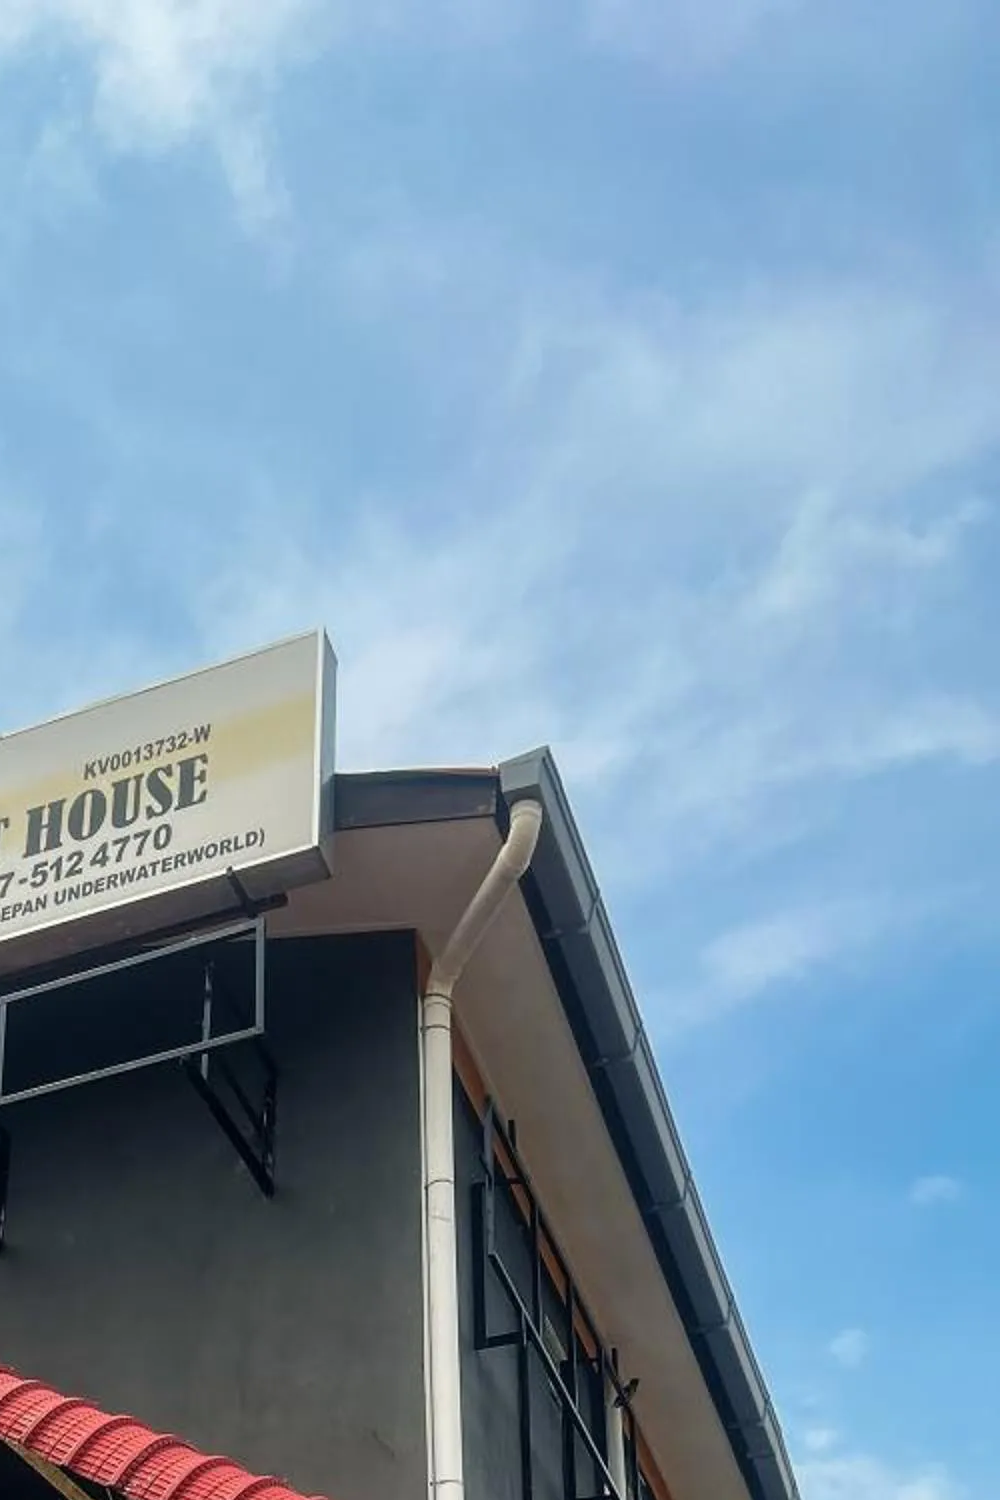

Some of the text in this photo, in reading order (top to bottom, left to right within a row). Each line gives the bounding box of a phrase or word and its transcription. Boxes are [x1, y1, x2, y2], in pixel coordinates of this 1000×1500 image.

[83, 723, 212, 780] KV0013732-W
[22, 752, 210, 859] HOUSE
[54, 827, 266, 907] UNDERWATERWORLD)
